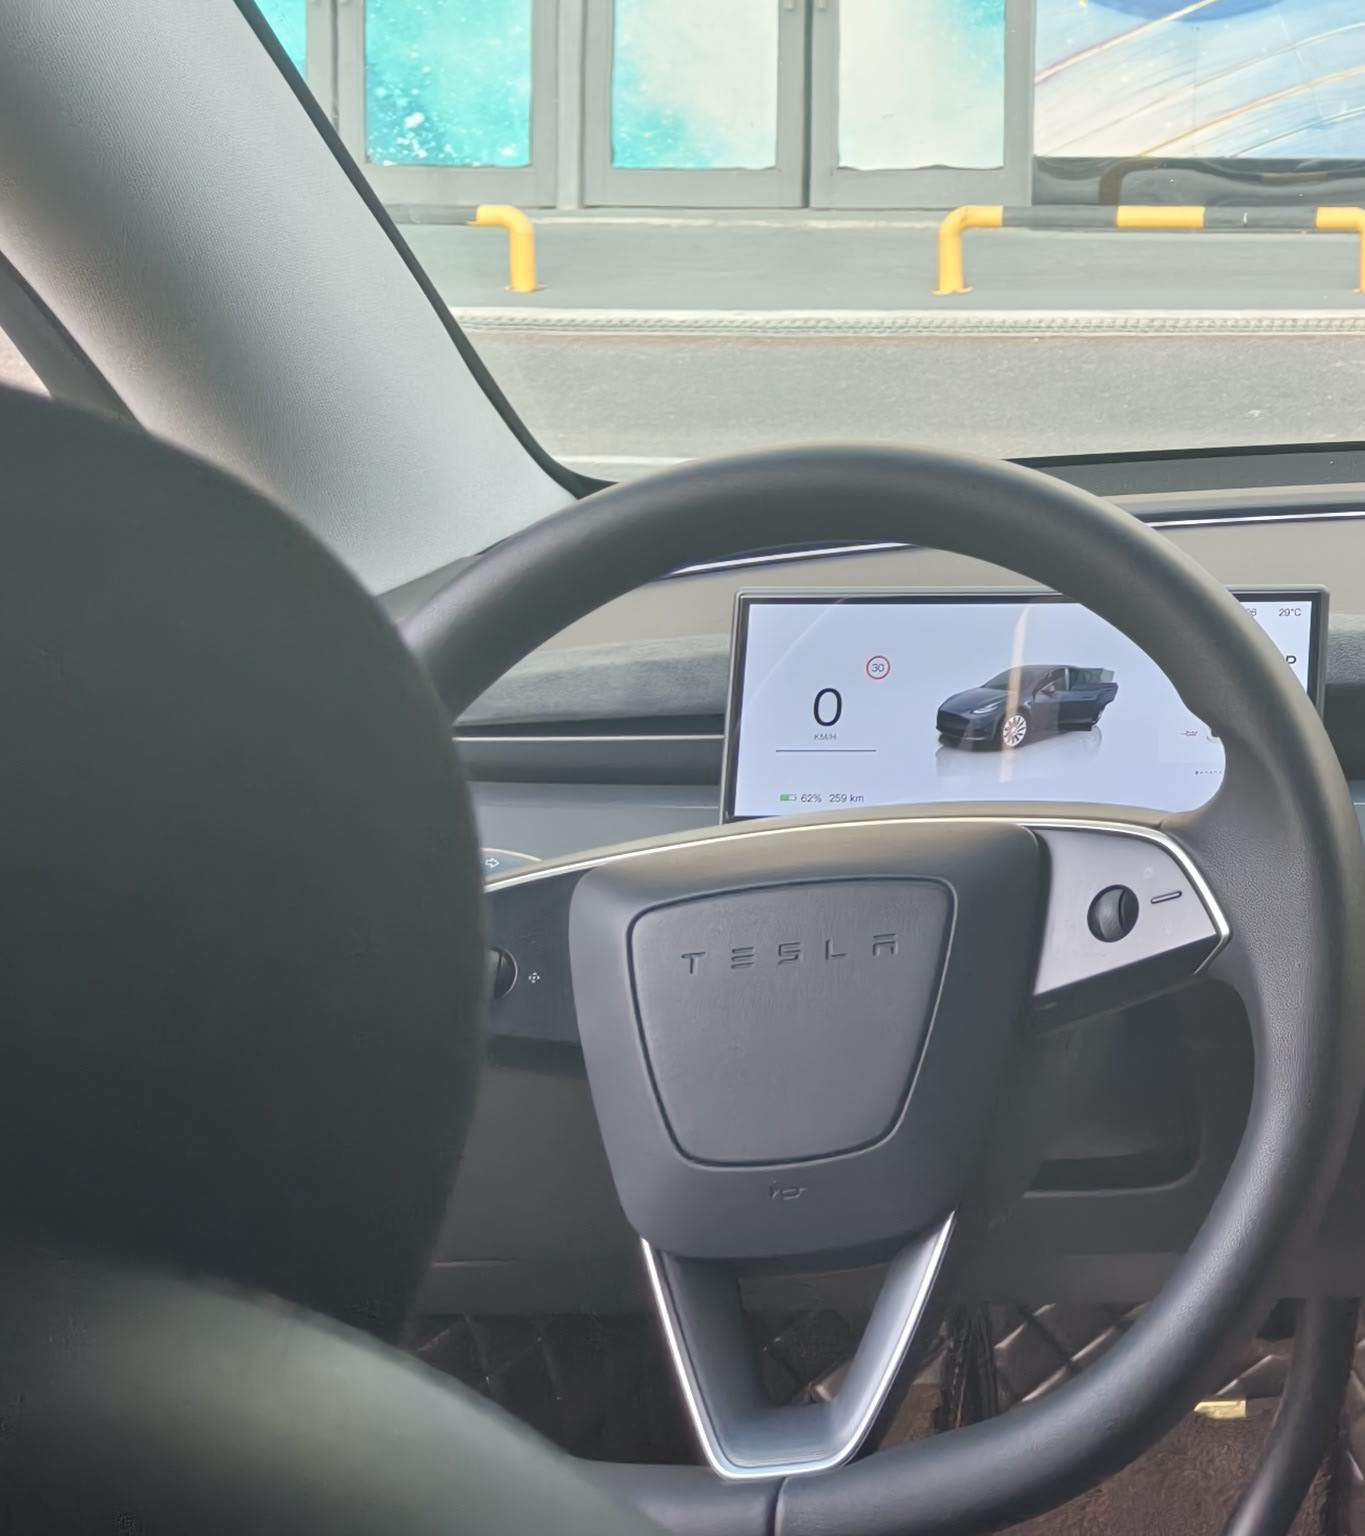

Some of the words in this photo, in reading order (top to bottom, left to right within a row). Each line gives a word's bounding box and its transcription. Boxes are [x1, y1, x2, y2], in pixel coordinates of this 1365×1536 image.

[871, 664, 885, 672] 30
[813, 687, 842, 727] 0
[801, 794, 822, 803] 62%
[829, 794, 847, 803] 259
[850, 794, 864, 802] km
[681, 933, 897, 974] TESLA
